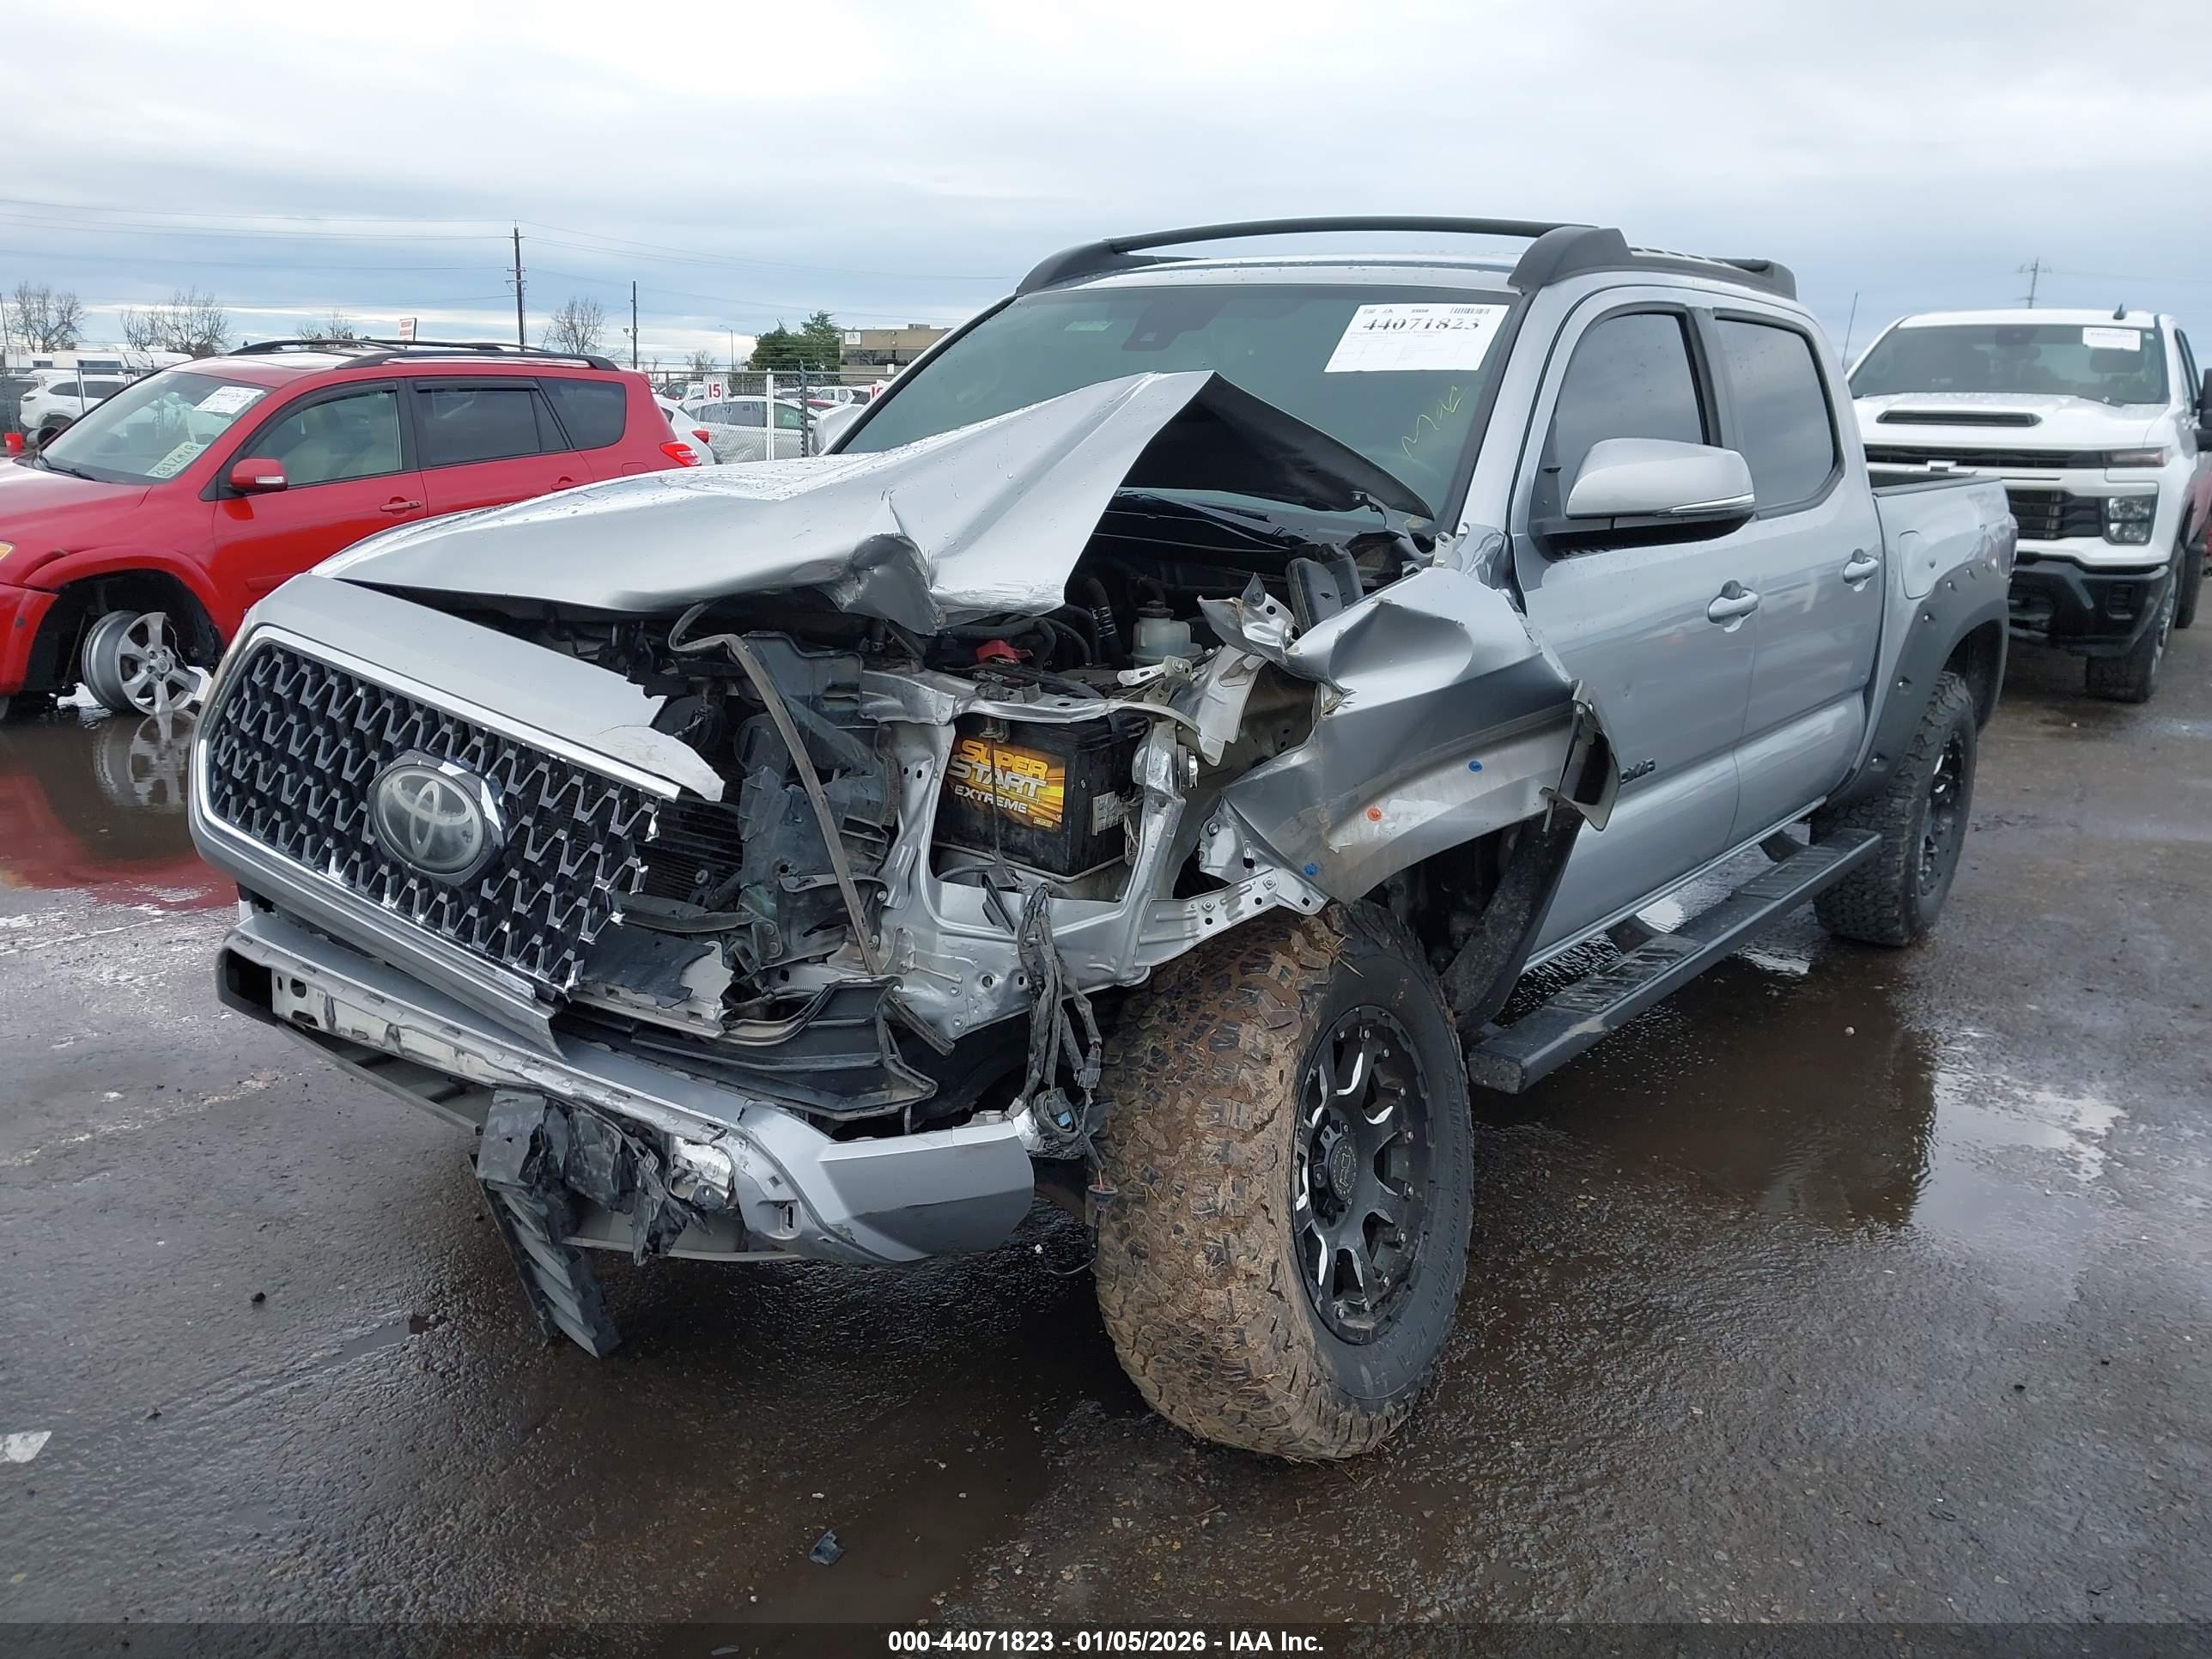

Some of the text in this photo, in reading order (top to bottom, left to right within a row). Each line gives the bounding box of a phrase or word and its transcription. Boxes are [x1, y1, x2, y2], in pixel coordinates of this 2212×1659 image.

[1362, 317, 1480, 331] 44071823
[708, 383, 721, 398] 15
[962, 739, 1048, 780] SUPER
[947, 754, 1047, 798] START
[955, 785, 1028, 814] EXTREME
